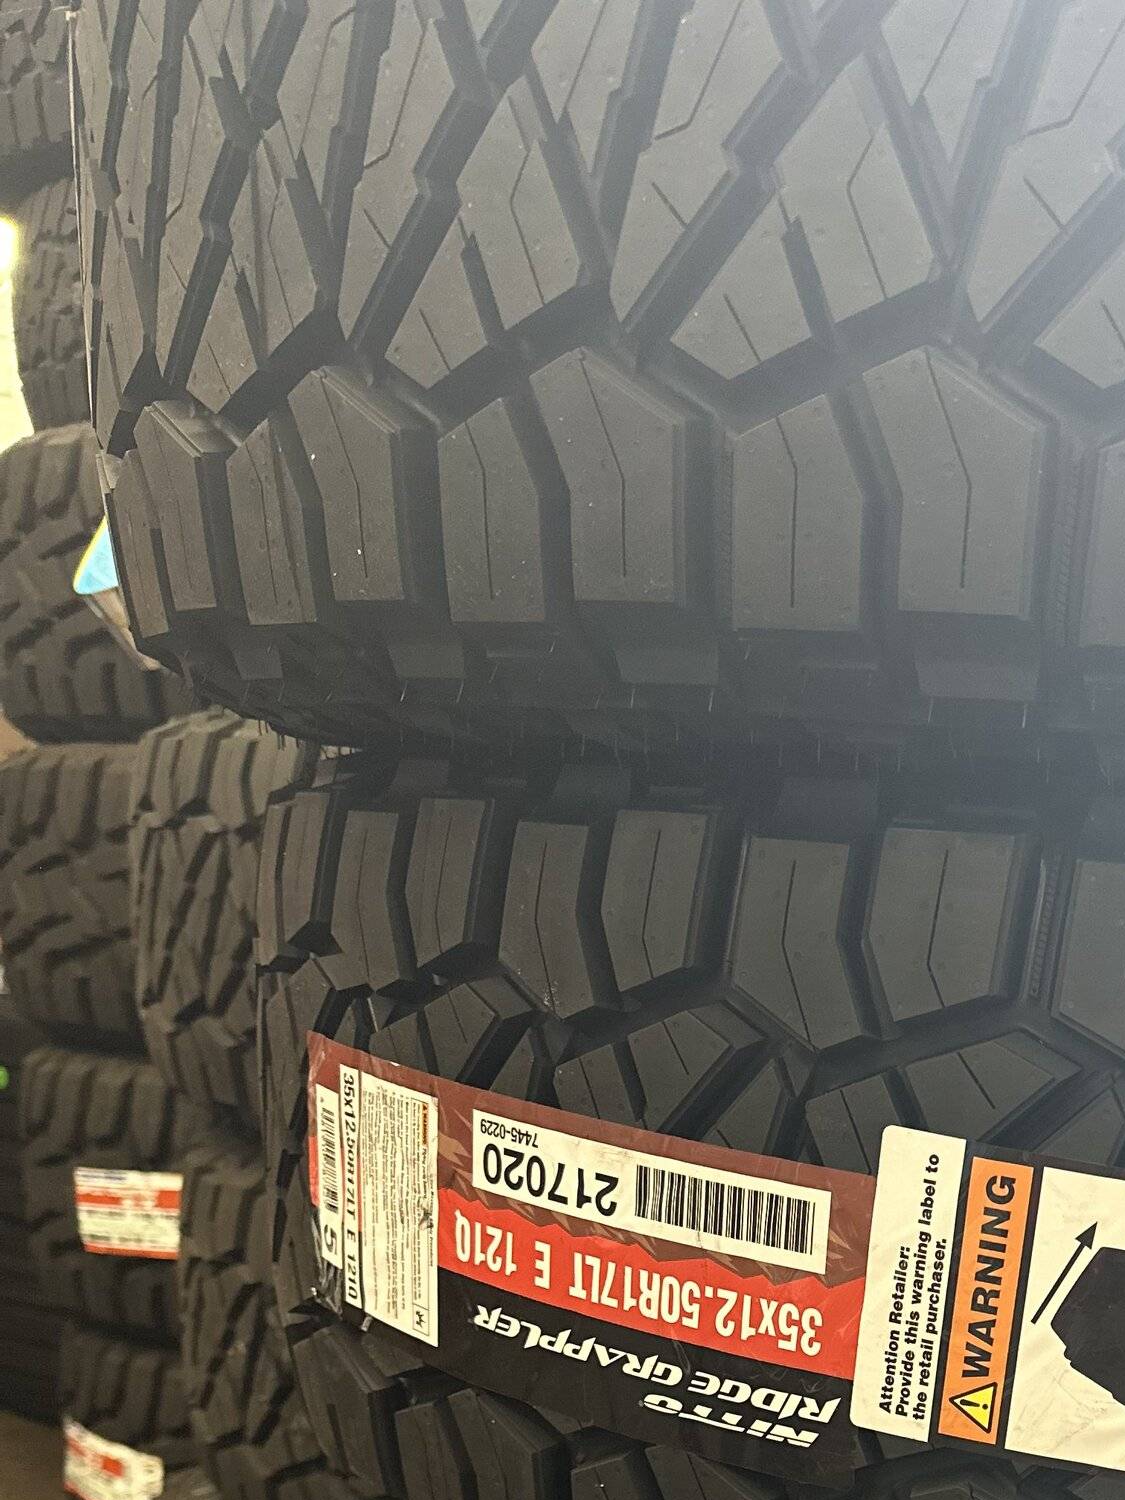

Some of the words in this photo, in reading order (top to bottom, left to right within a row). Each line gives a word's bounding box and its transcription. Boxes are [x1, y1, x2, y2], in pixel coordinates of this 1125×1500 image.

[481, 1119, 538, 1148] 7445-0229
[924, 1152, 939, 1174] to
[483, 1143, 619, 1216] 217020
[918, 1178, 936, 1225] label
[323, 1224, 338, 1254] 5
[454, 1209, 518, 1276] 121Q
[534, 1240, 550, 1290] E
[908, 1230, 932, 1306] warning
[569, 1251, 823, 1356] 35x12.50R17LT
[889, 1245, 909, 1324] Retailer:
[922, 1236, 949, 1334] purchaser.
[961, 1174, 1016, 1378] WARNING
[473, 1304, 683, 1386] GRAPPLER
[903, 1309, 919, 1345] this
[879, 1328, 900, 1413] Attention
[895, 1348, 914, 1416] Provide
[916, 1338, 933, 1386] retail
[643, 1393, 819, 1448] NITTO
[688, 1371, 841, 1424] RIDGE
[912, 1390, 927, 1421] the
